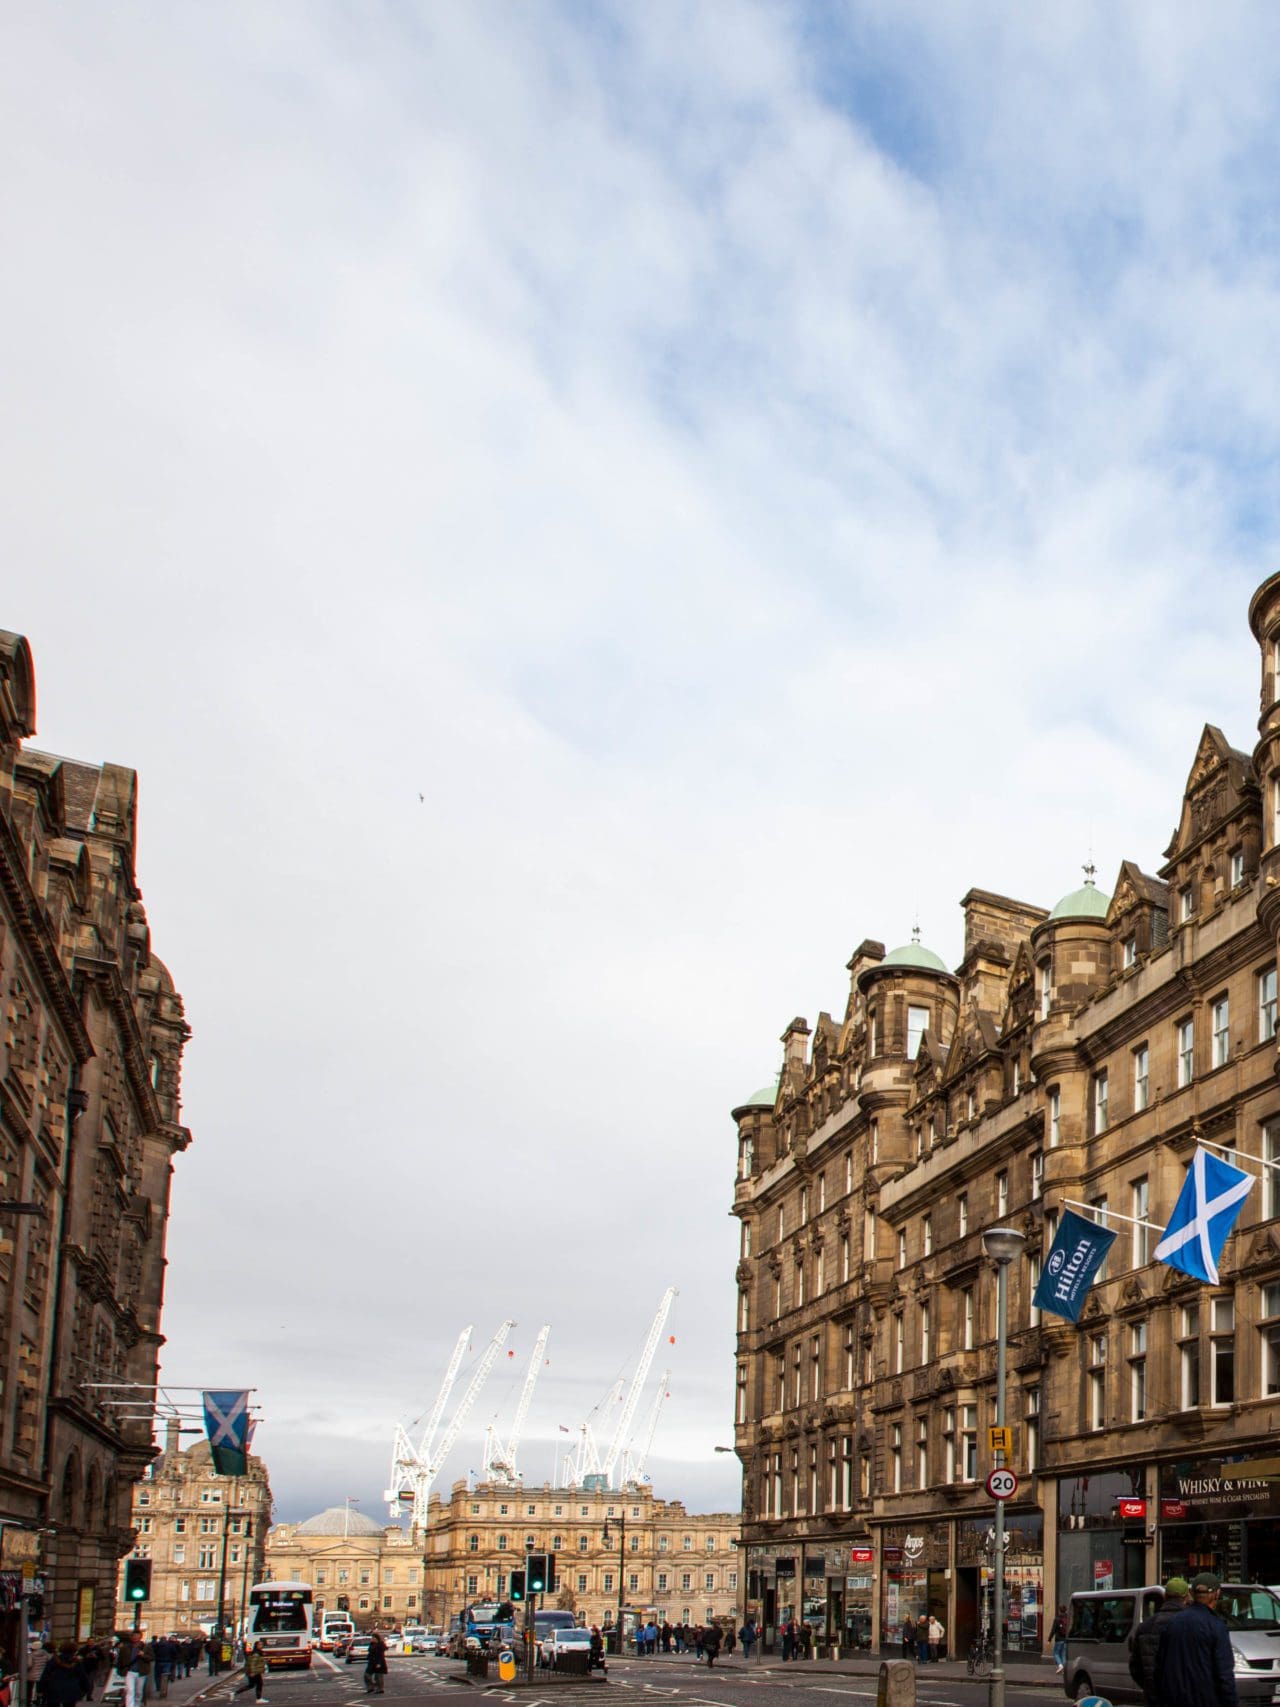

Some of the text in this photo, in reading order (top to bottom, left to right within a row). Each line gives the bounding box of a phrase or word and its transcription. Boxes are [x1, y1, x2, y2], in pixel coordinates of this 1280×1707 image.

[1054, 1240, 1091, 1301] Hilton
[991, 1429, 1006, 1447] H
[992, 1477, 1014, 1490] 20
[1179, 1478, 1222, 1496] WHISKY
[1224, 1479, 1234, 1491] &
[1124, 1503, 1142, 1512] Argos
[904, 1534, 924, 1553] Argos
